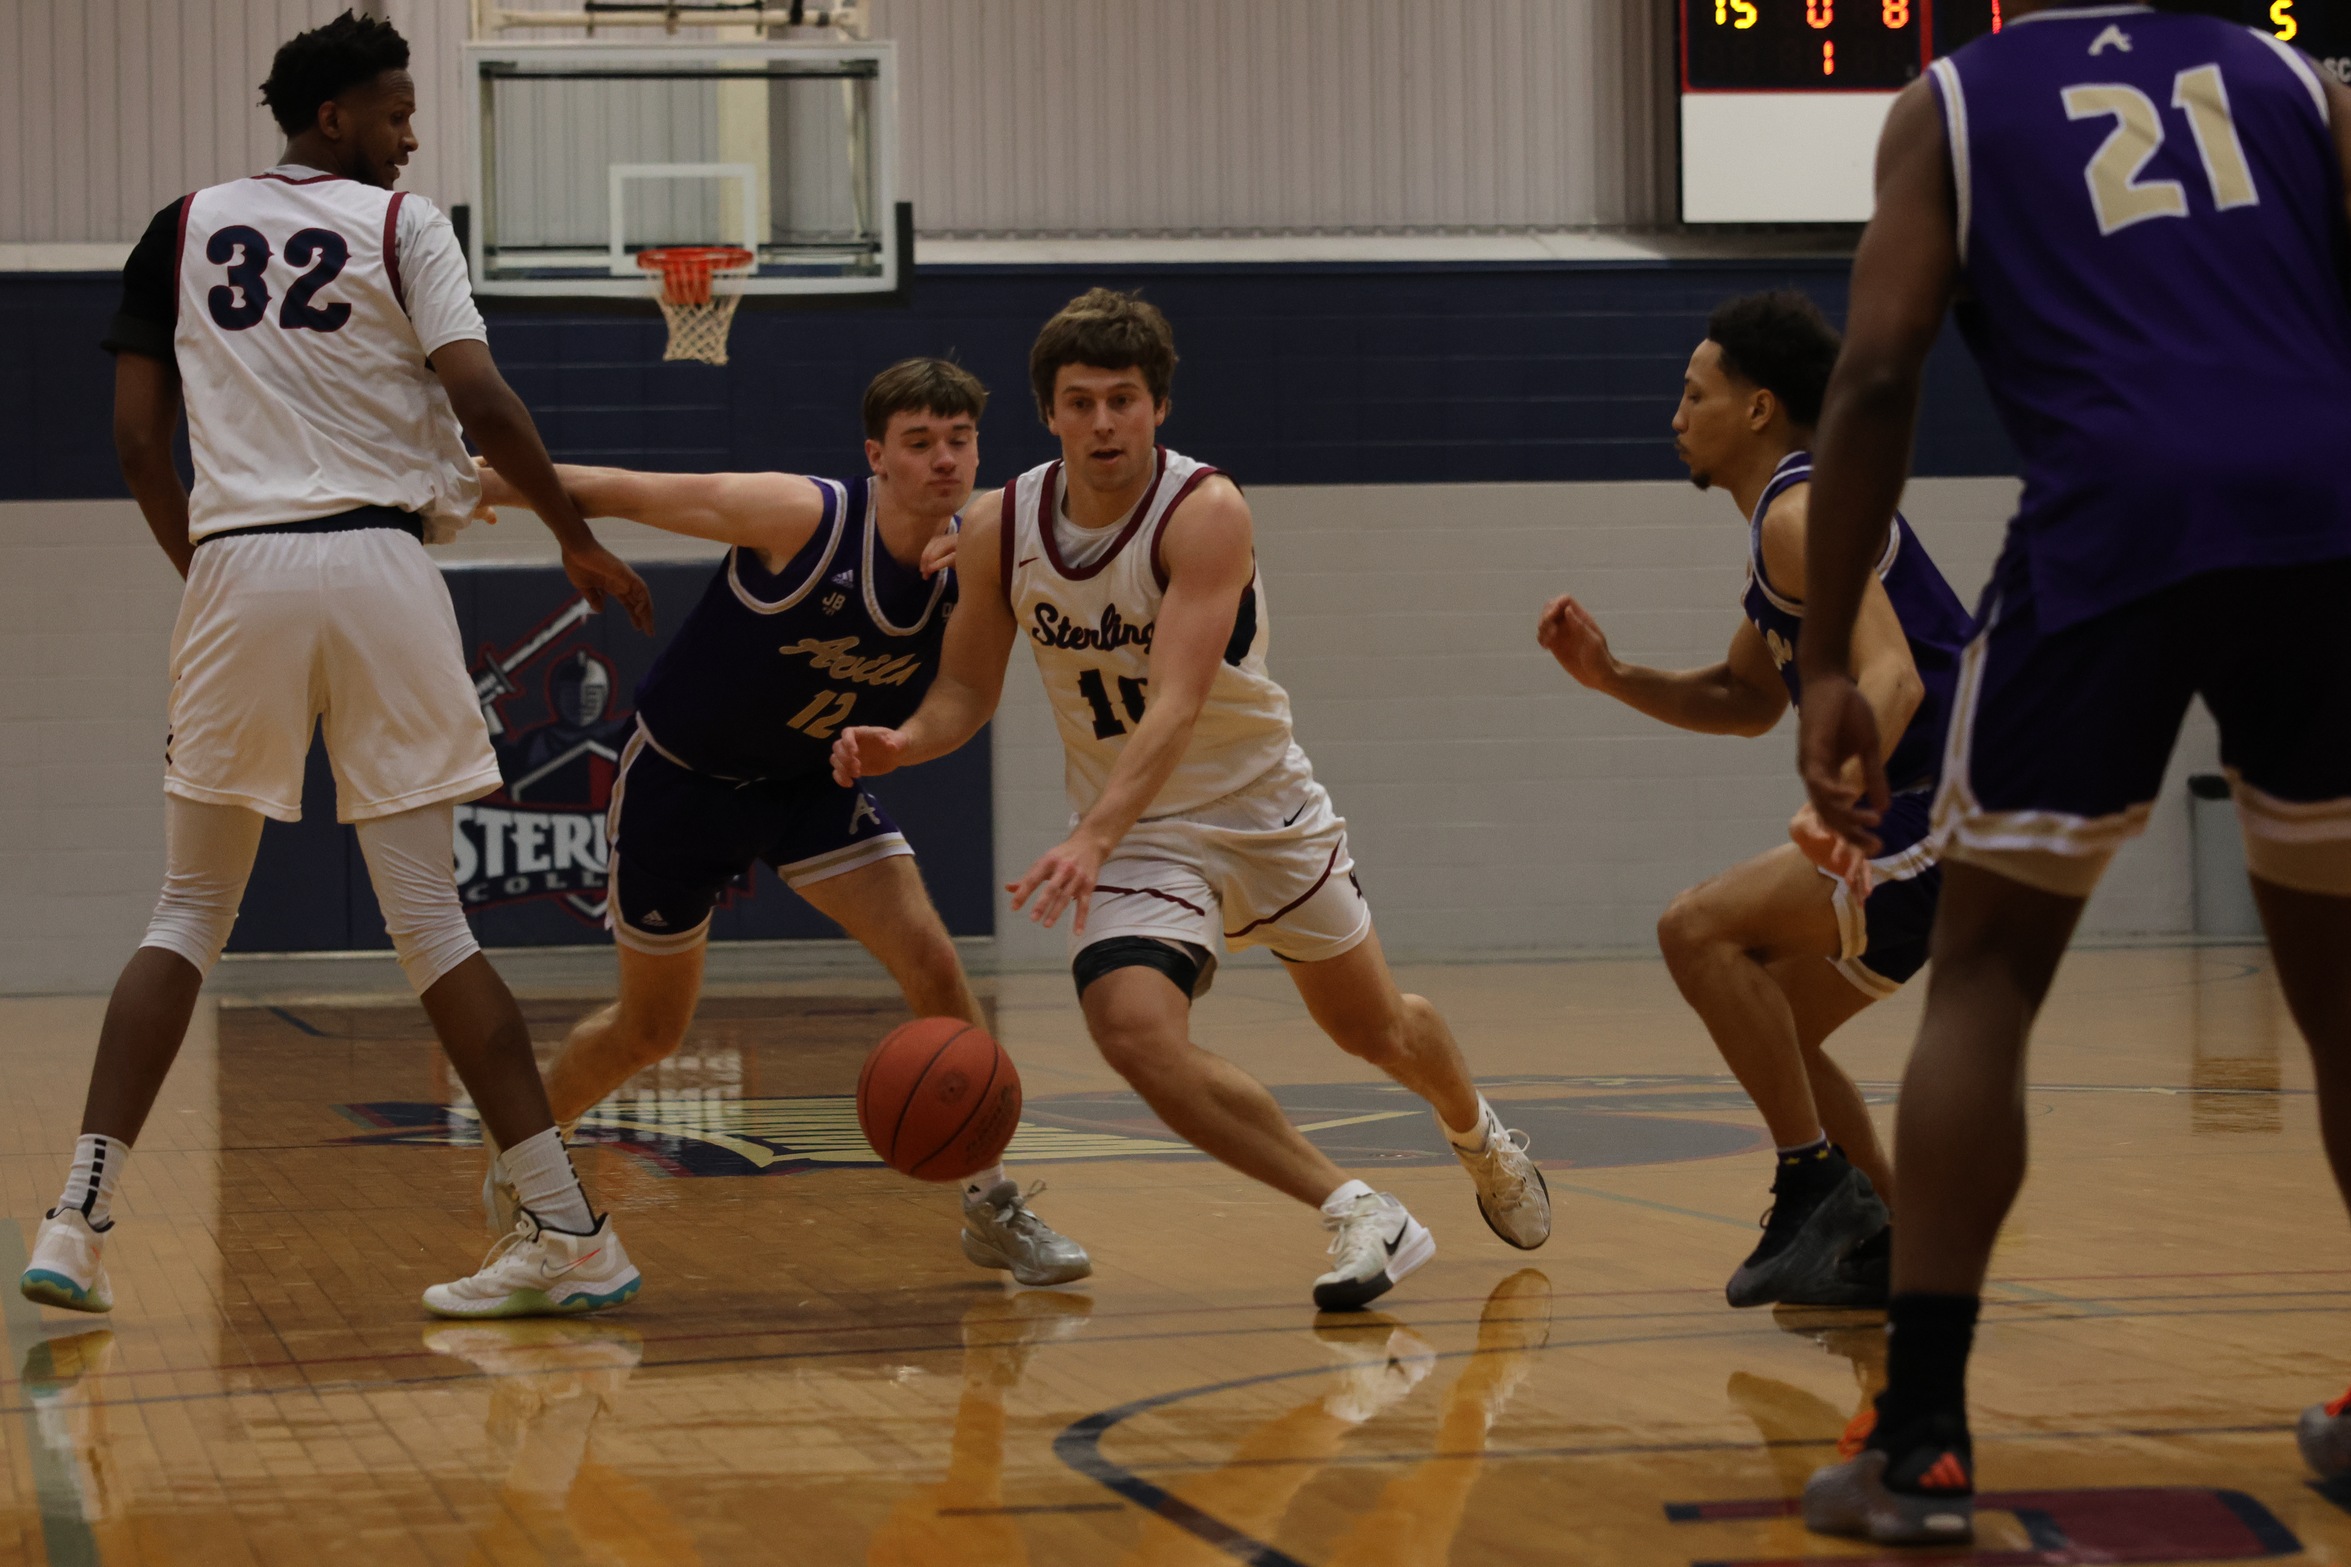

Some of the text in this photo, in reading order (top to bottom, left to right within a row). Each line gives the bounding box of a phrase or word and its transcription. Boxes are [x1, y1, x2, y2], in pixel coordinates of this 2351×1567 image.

[1822, 39, 1835, 76] 1
[2060, 63, 2259, 237] 21
[206, 225, 352, 332] 32
[785, 689, 859, 739] 12
[848, 792, 881, 836] A
